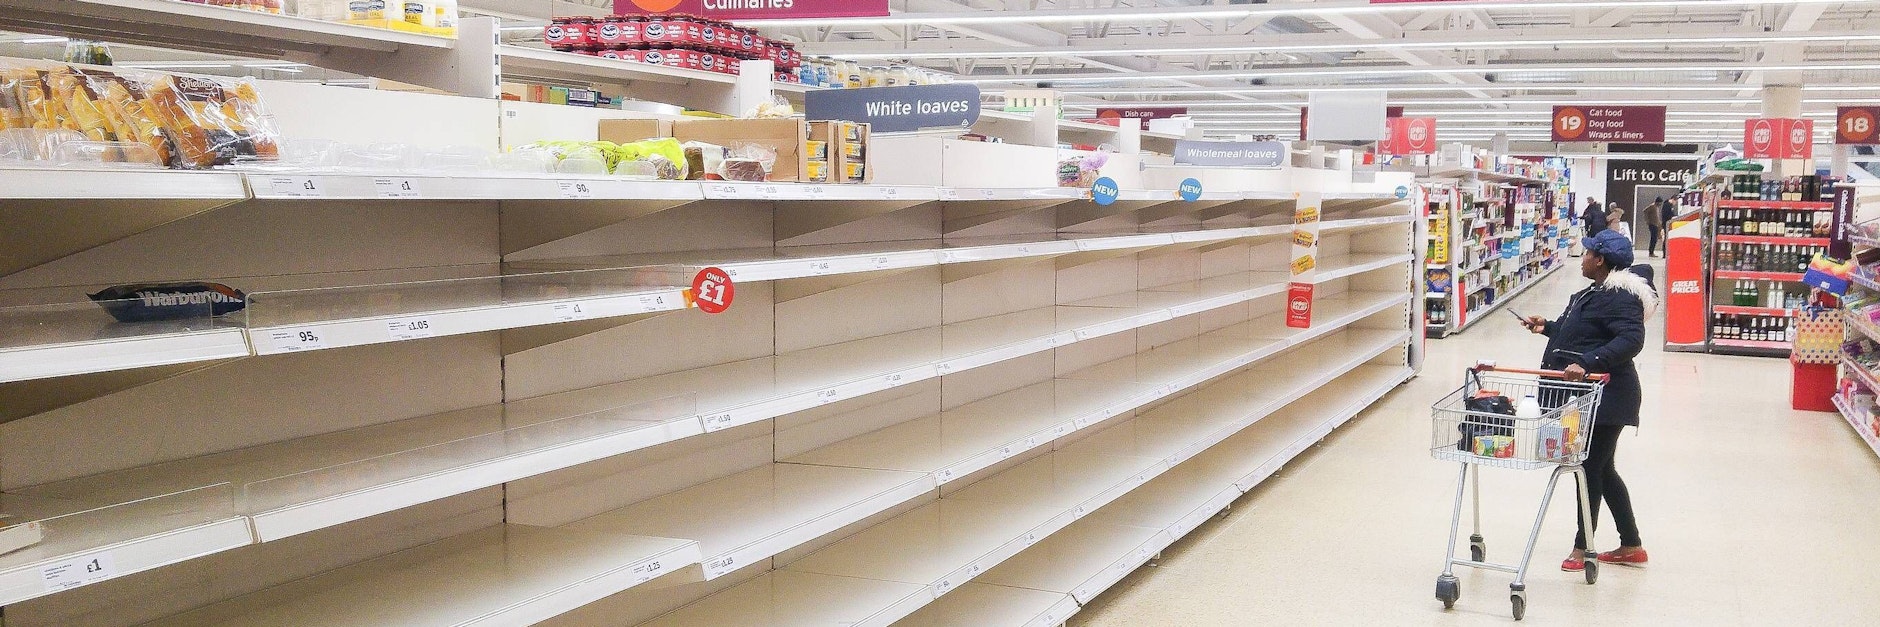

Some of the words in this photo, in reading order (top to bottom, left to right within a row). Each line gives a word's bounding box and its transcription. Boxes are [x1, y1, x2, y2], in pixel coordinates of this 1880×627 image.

[703, 0, 794, 10] Culinaries
[866, 101, 912, 117] White
[917, 100, 969, 114] loaves
[1590, 108, 1603, 116] Cat
[1605, 108, 1622, 117] food
[1560, 116, 1582, 130] 19
[1589, 120, 1604, 129] Dog
[1607, 120, 1624, 128] food
[1845, 117, 1869, 132] 18
[1589, 131, 1612, 140] Wraps
[1614, 131, 1621, 139] &
[1622, 131, 1644, 139] liners
[1187, 148, 1242, 158] Wholemeal
[1244, 148, 1277, 158] loaves
[1613, 169, 1637, 181] Lift
[1641, 171, 1656, 181] to
[1659, 168, 1690, 182] Café
[303, 179, 316, 190] £1
[401, 180, 411, 191] £1
[1181, 184, 1201, 195] NEW
[1094, 184, 1117, 197] NEW
[706, 272, 726, 283] ONLY
[699, 280, 726, 306] £1
[408, 320, 429, 331] £1.05
[299, 331, 319, 343] 95p
[86, 558, 102, 573] £1
